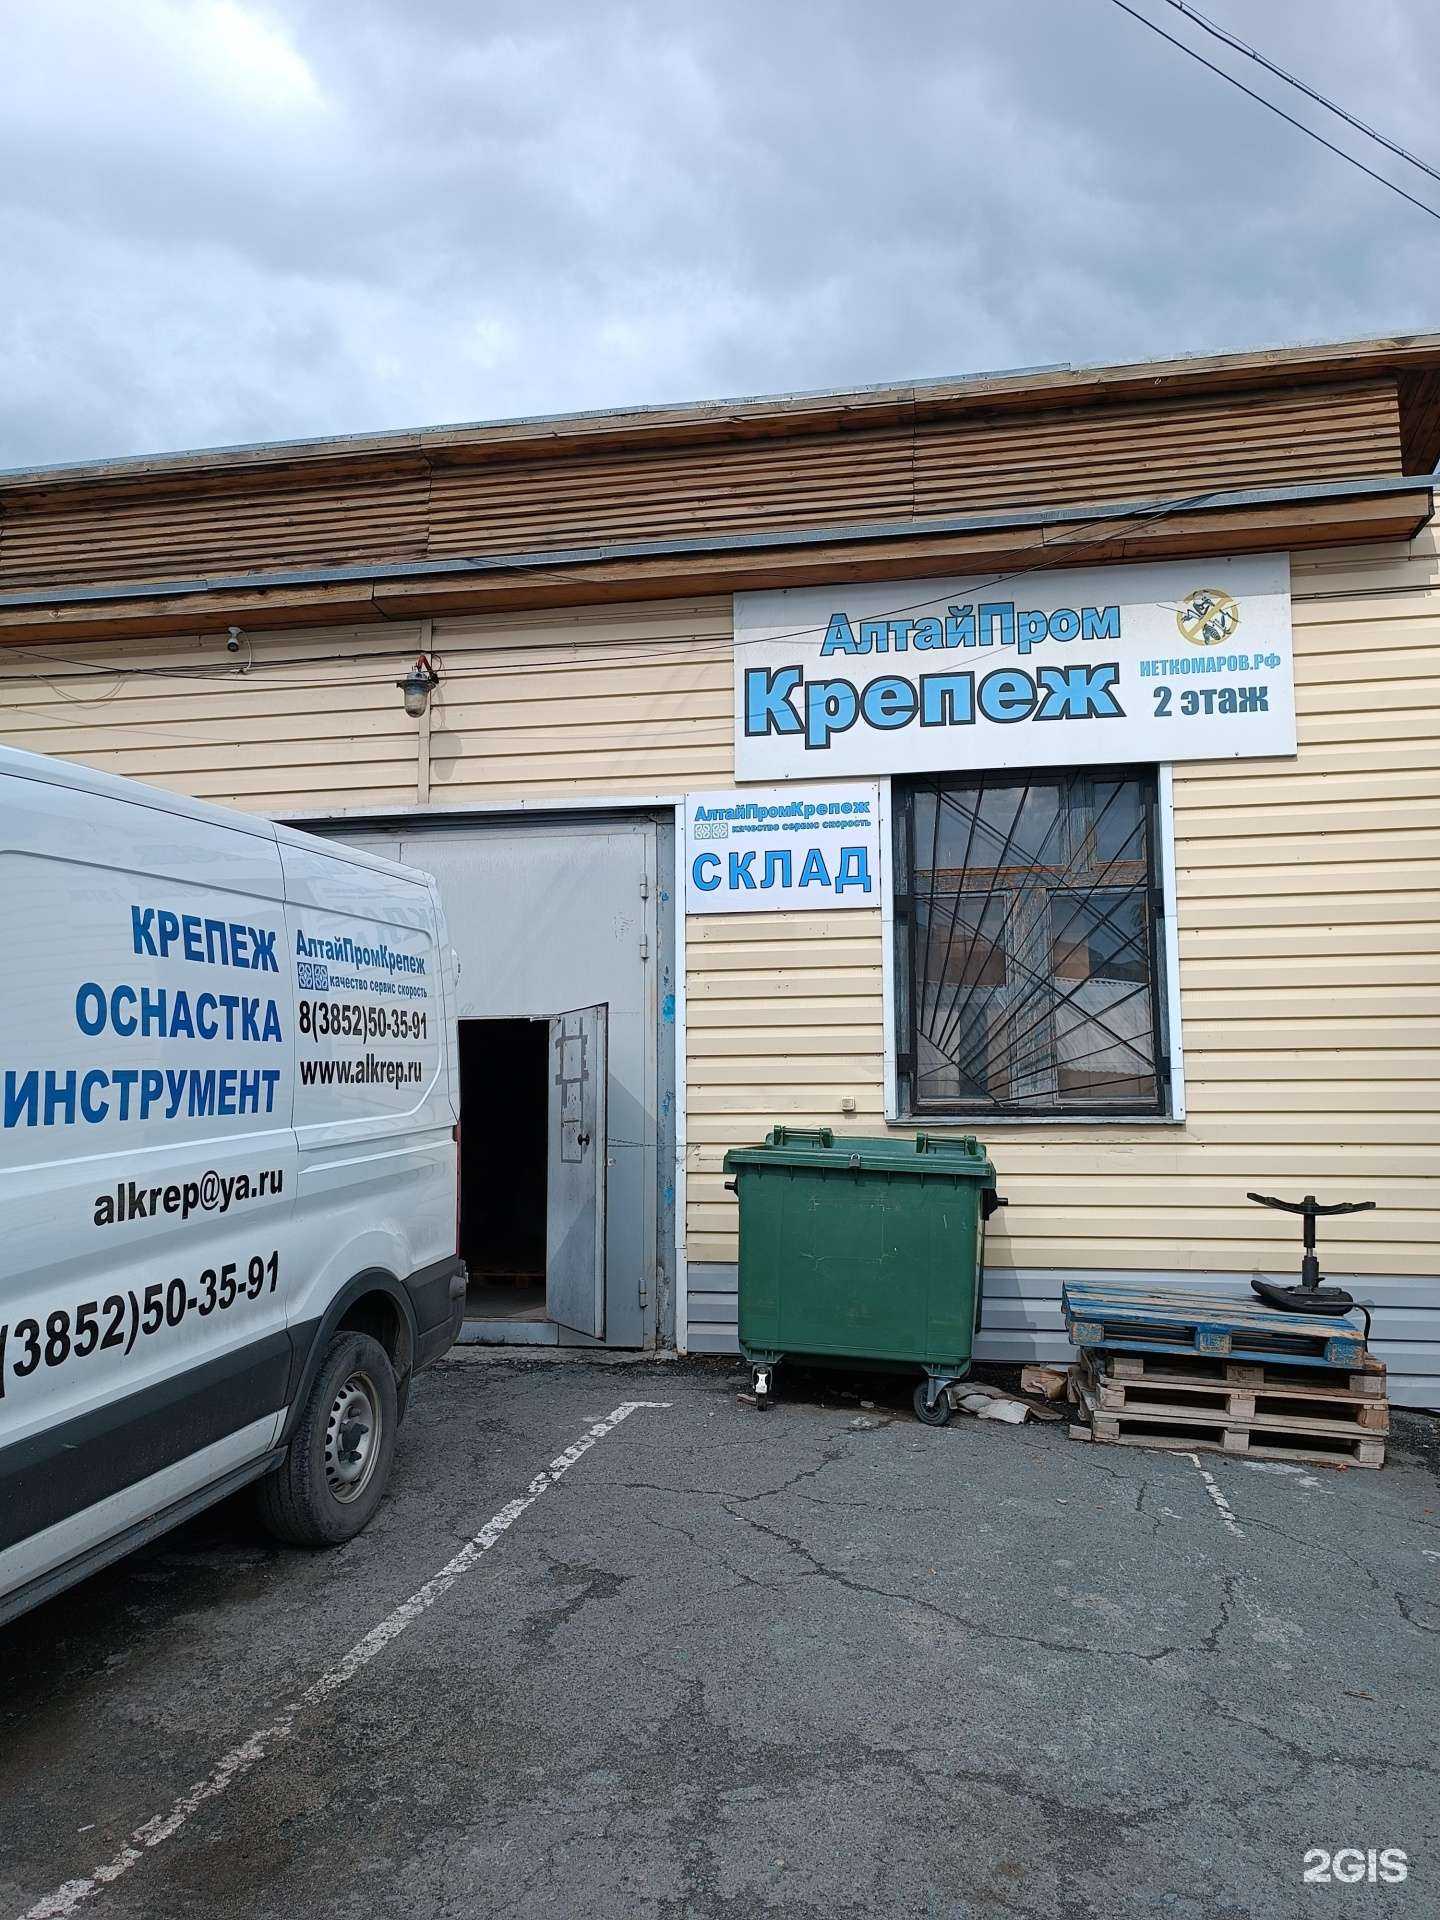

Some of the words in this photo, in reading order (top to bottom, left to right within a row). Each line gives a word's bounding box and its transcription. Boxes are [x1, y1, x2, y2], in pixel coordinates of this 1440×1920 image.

[820, 601, 1121, 657] АлтайПром
[744, 661, 1126, 750] Крепеж
[1153, 686, 1173, 717] 2
[1180, 686, 1269, 716] этаж
[694, 800, 871, 822] АлтайПромКрепеж
[731, 822, 780, 833] качество
[782, 821, 820, 832] сервис
[822, 819, 872, 829] скорость
[692, 846, 872, 894] СКЛАД
[131, 904, 280, 973] КРЕПЕЖ
[296, 929, 426, 976] АлтайПромКрепеж
[329, 975, 368, 991] качество
[369, 978, 396, 996] сервис
[397, 983, 428, 999] скорость
[75, 982, 283, 1043] ОСНАСТКА
[299, 1000, 428, 1045] 8(3852)50-35-91
[300, 1053, 422, 1090] www.alkrep.ru
[3, 1069, 281, 1129] ИНСТРУМЕНТ
[93, 1169, 283, 1227] alkrep@ya.ru
